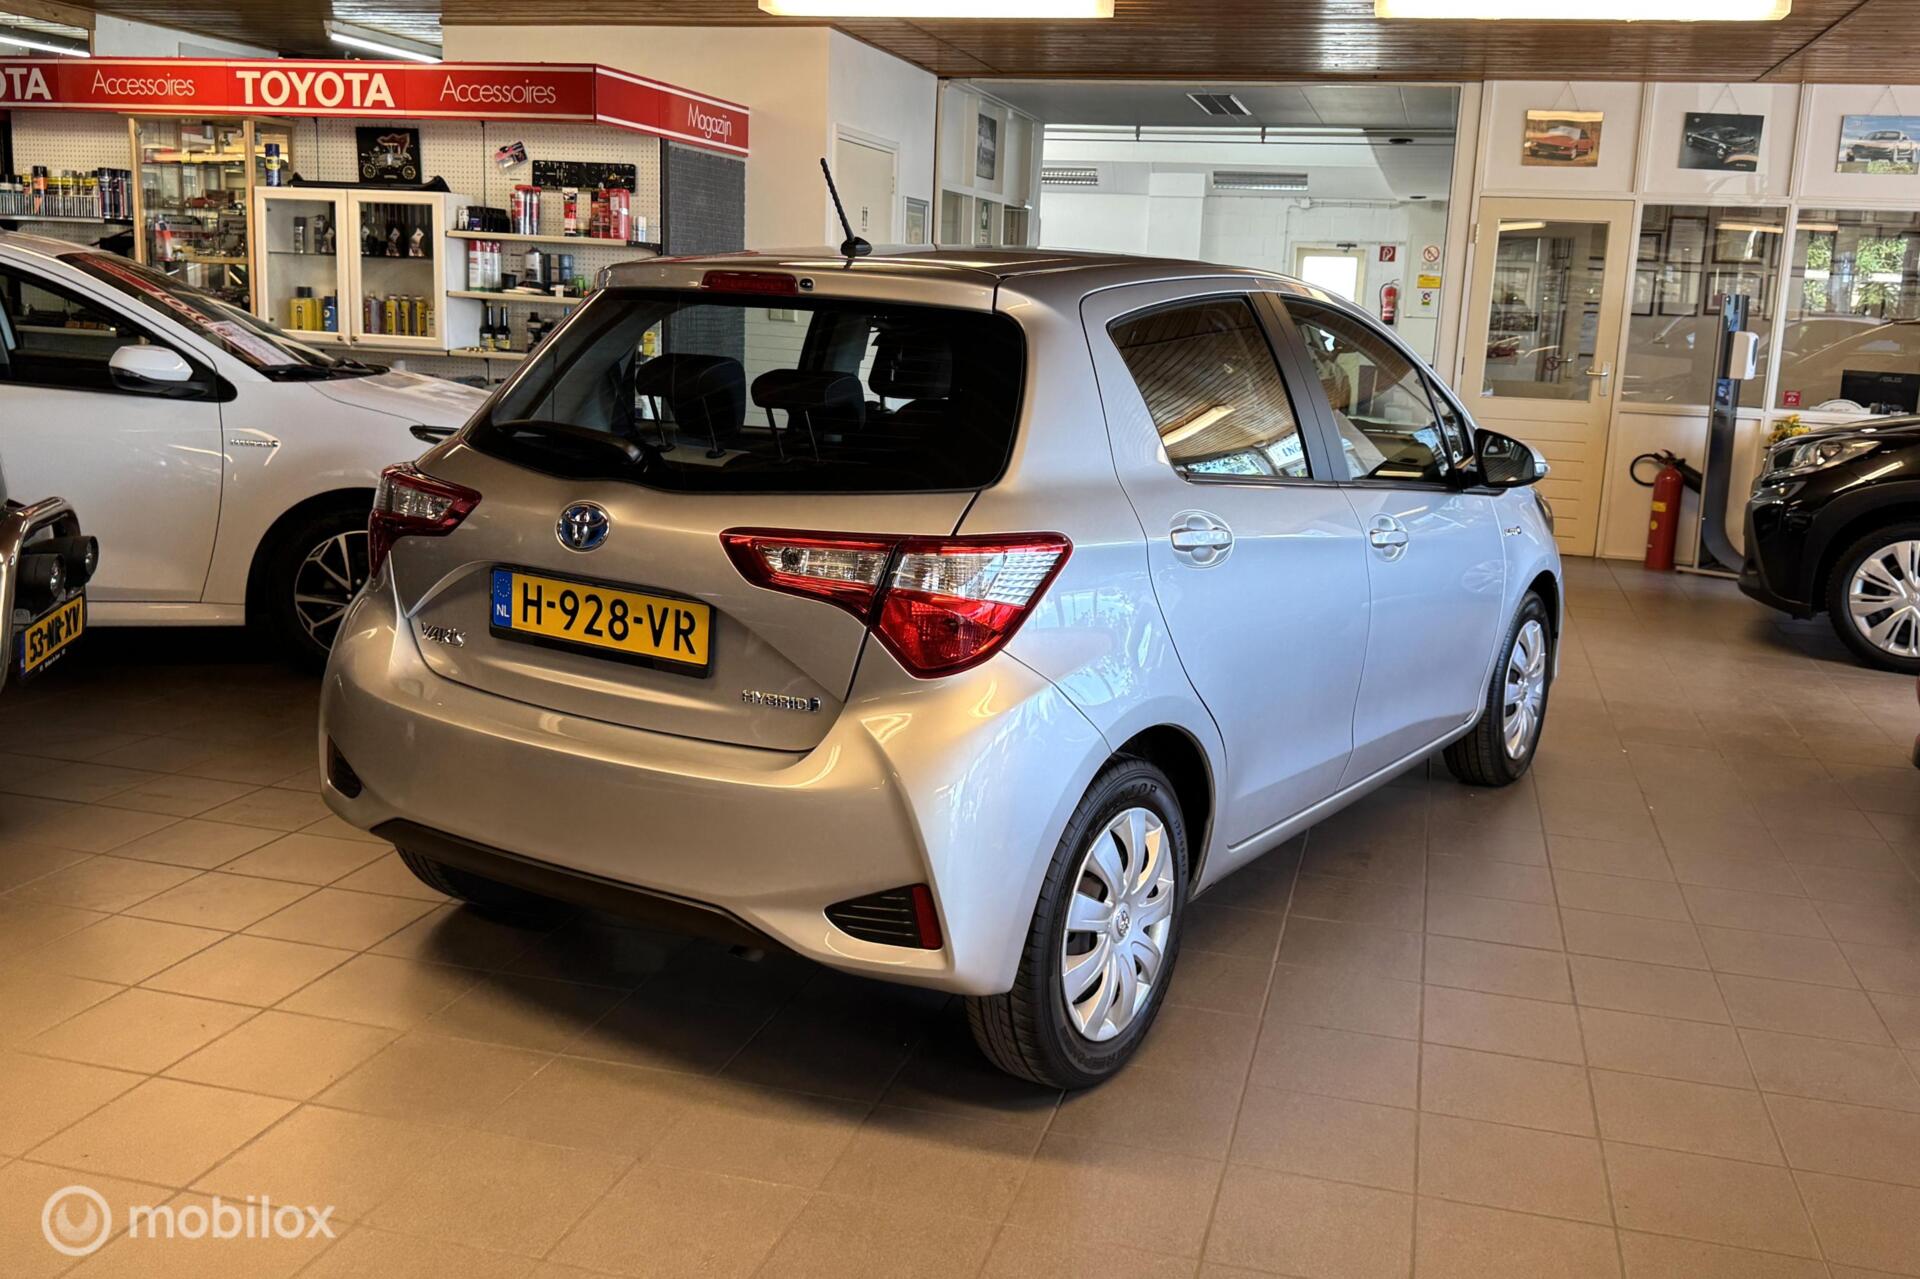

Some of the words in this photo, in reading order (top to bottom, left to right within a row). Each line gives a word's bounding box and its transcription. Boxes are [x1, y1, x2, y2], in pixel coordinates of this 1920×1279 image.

[0, 67, 52, 100] TA
[92, 69, 196, 96] Accessoires
[235, 70, 396, 108] TOYOTA
[440, 74, 556, 104] Accessoires
[687, 103, 732, 144] Magazijn
[496, 603, 510, 618] NL
[522, 582, 697, 655] H-928-VR
[421, 621, 466, 647] YARIS
[742, 689, 808, 710] HYBRID
